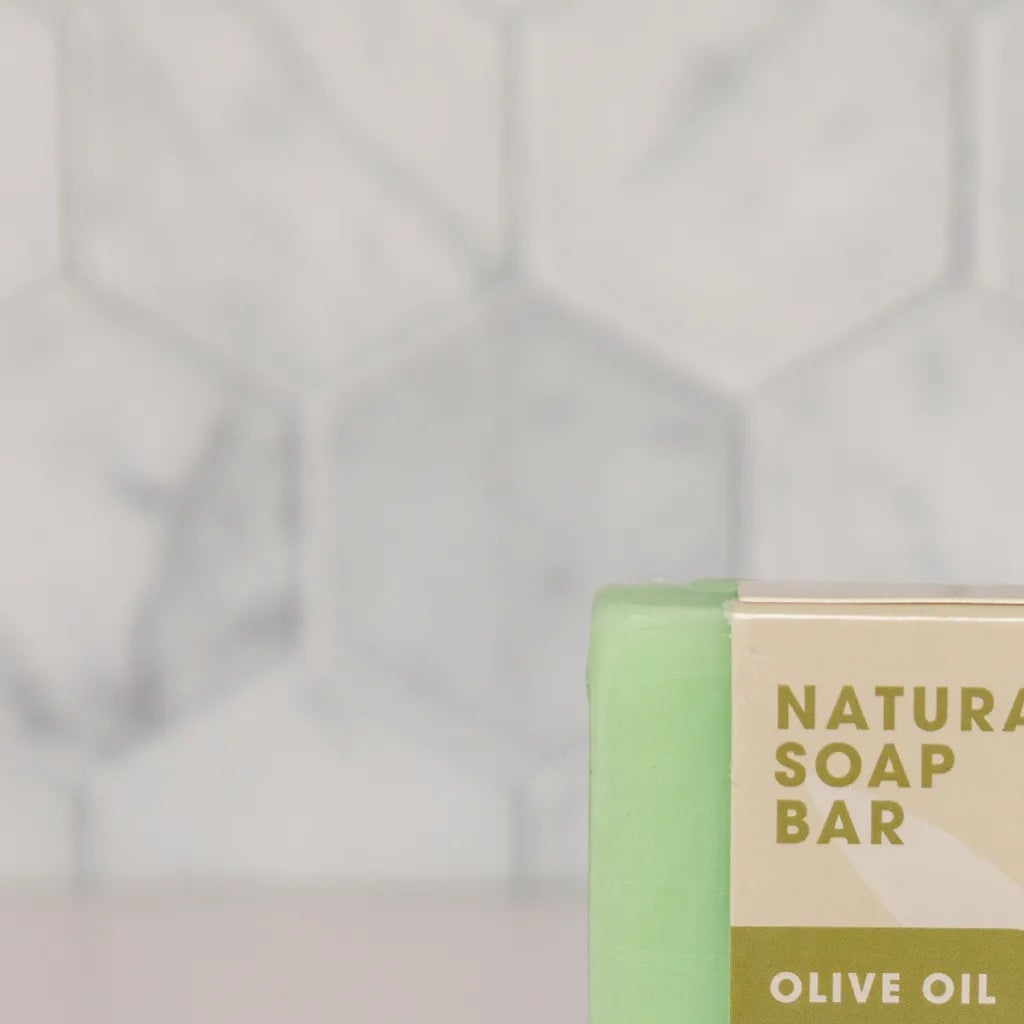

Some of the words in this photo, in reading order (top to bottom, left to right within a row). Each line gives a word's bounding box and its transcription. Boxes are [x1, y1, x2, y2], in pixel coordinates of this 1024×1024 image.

[774, 741, 955, 789] SOAP
[775, 799, 905, 845] BAR
[769, 971, 901, 1004] OLIVE
[921, 971, 996, 1005] OIL
